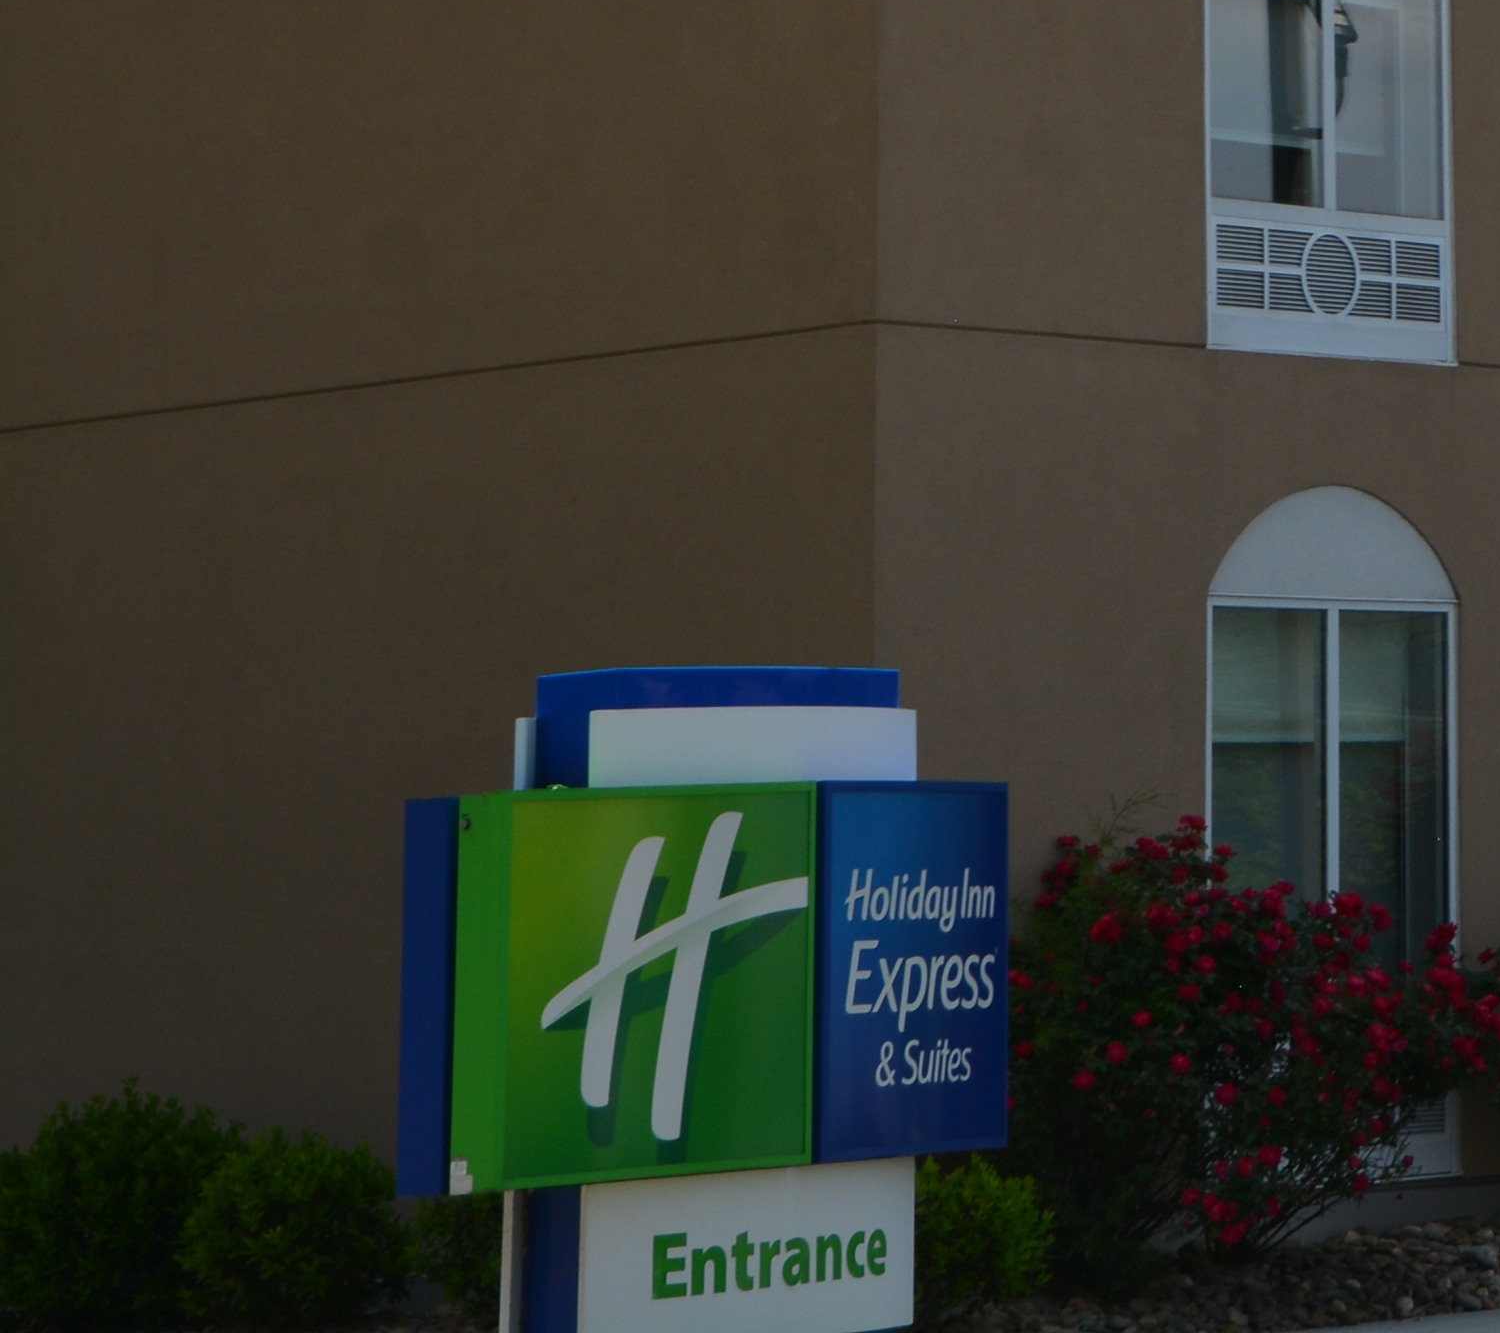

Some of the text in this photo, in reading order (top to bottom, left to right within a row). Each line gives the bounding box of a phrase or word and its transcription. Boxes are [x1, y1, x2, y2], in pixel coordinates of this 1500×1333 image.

[844, 867, 996, 933] Holiday Inn
[845, 939, 997, 1033] Express
[874, 1038, 973, 1088] & Suites
[651, 1228, 888, 1301] Entrance
